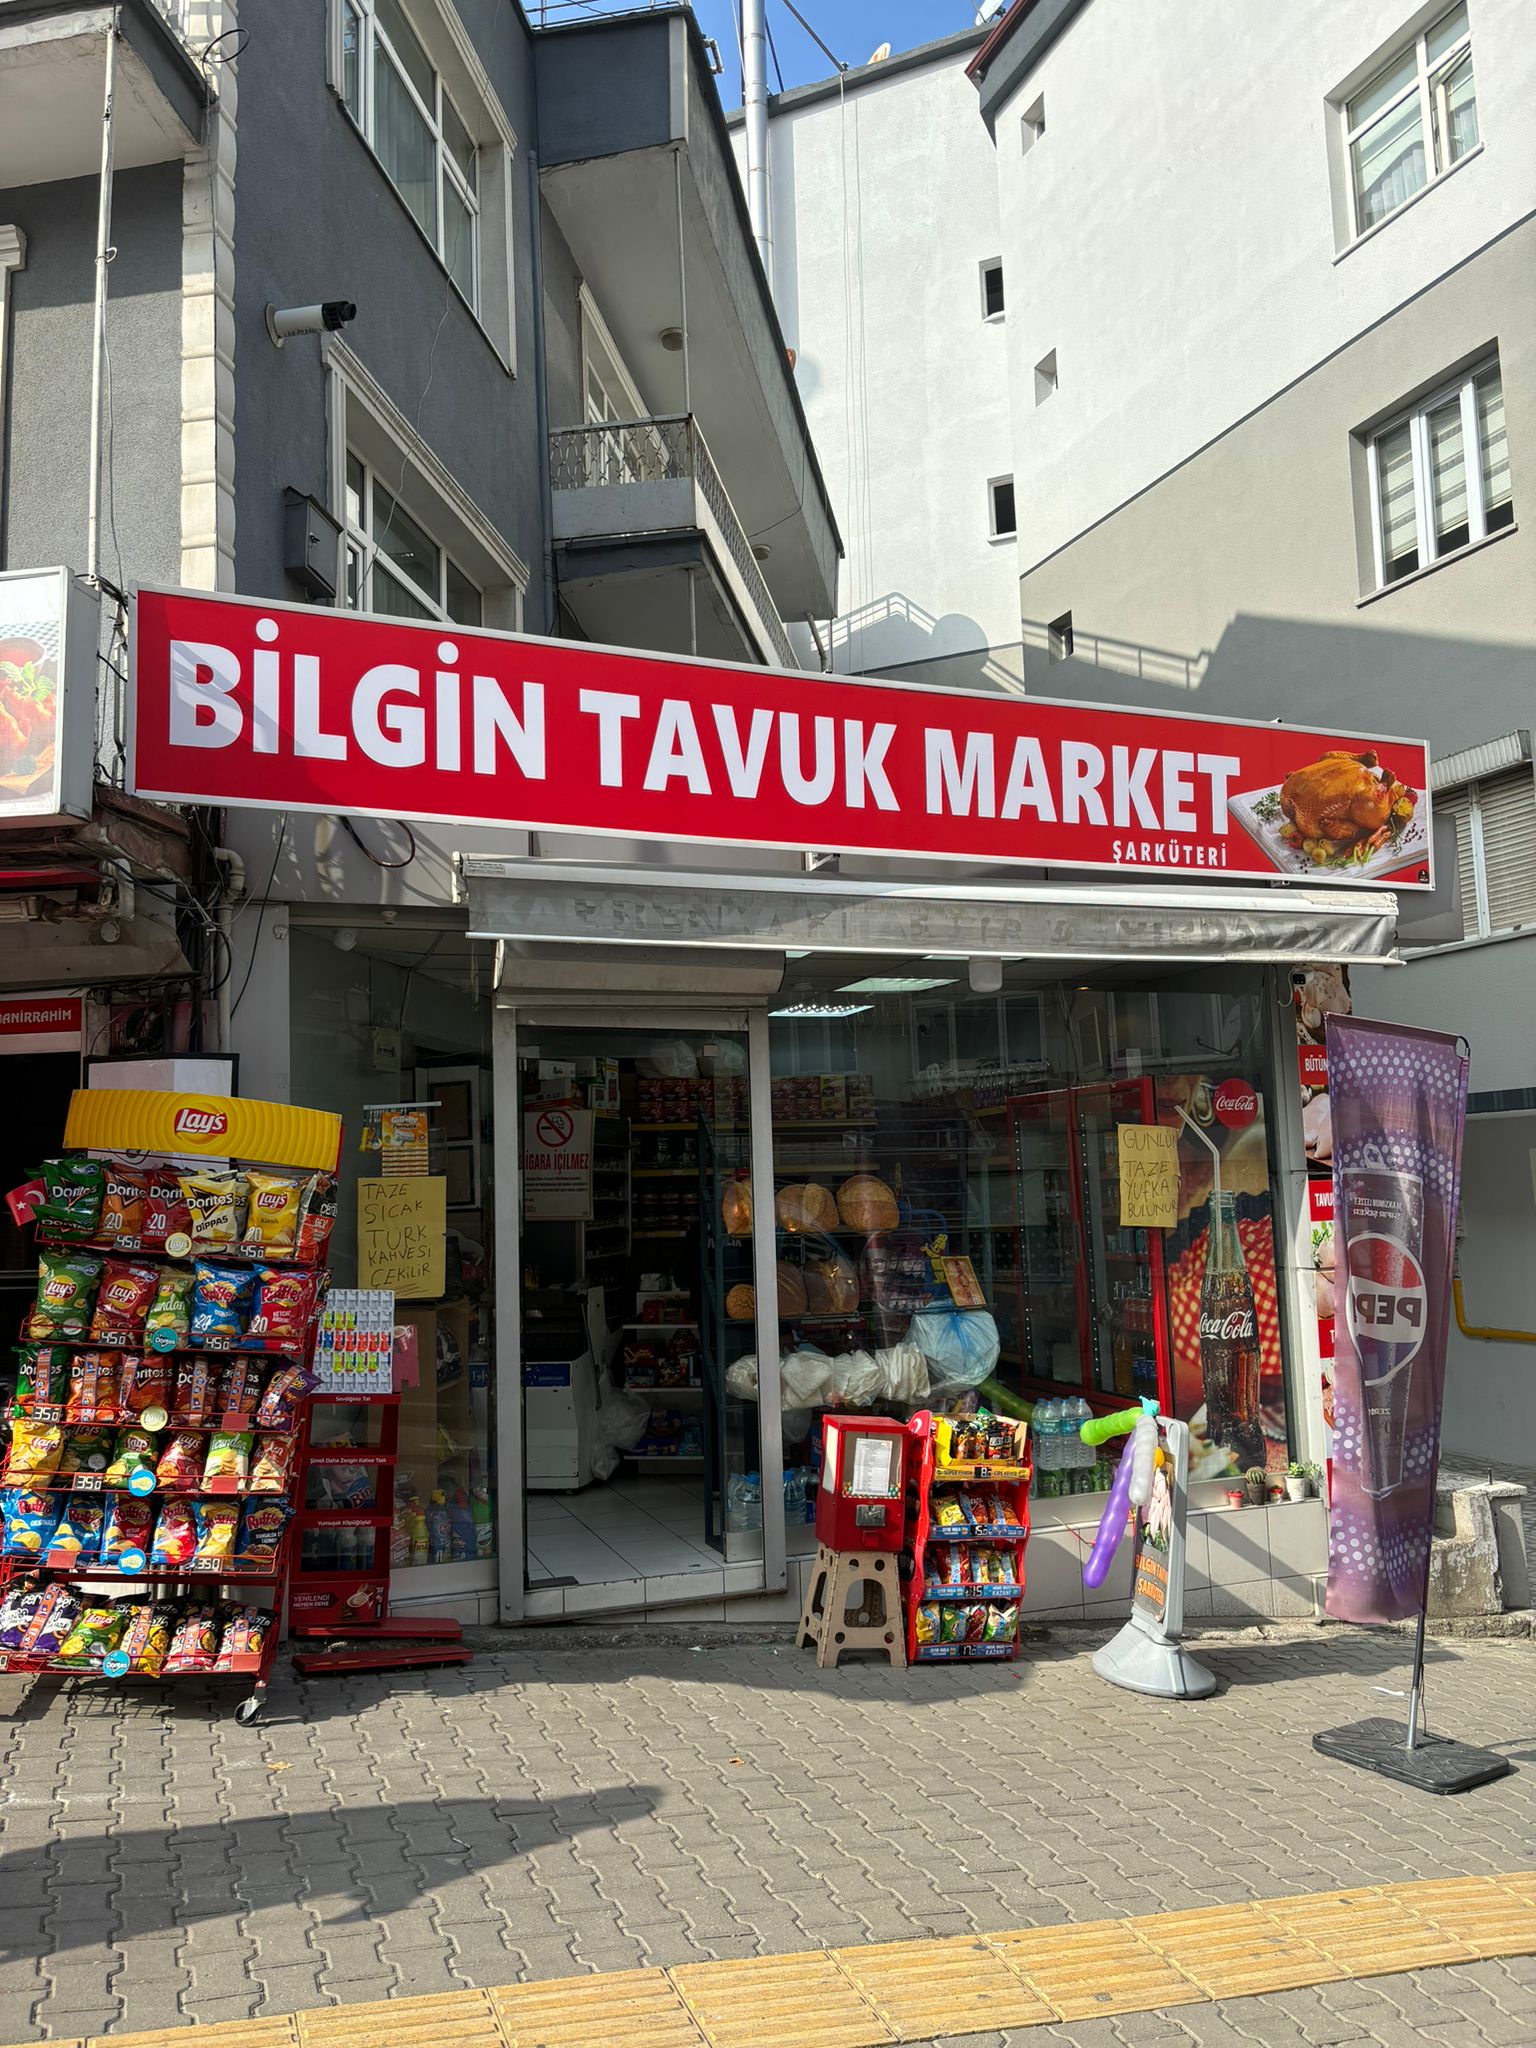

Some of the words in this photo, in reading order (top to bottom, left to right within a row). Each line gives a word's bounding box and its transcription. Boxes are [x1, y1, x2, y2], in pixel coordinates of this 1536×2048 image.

[169, 618, 546, 780] BİLGİN
[579, 688, 900, 812] TAVUK
[924, 727, 1240, 836] MARKET
[1112, 838, 1227, 867] ŞARKÜTERİ
[0, 1007, 72, 1025] ANİRRAHİM
[176, 1109, 226, 1135] Lay's
[554, 1150, 589, 1175] İÇİLMEZ
[1123, 1160, 1169, 1178] TAZE
[186, 1193, 234, 1210] Doritos
[258, 1193, 288, 1207] Lay's
[362, 1183, 410, 1200] TAZE
[365, 1200, 424, 1225] SICAK
[1128, 1202, 1178, 1218] BULUNUR
[366, 1225, 428, 1251] TÜRK
[368, 1245, 432, 1267] KAHVESİ
[370, 1262, 432, 1289] ÇEKİLİR
[107, 1284, 138, 1302] Lay's
